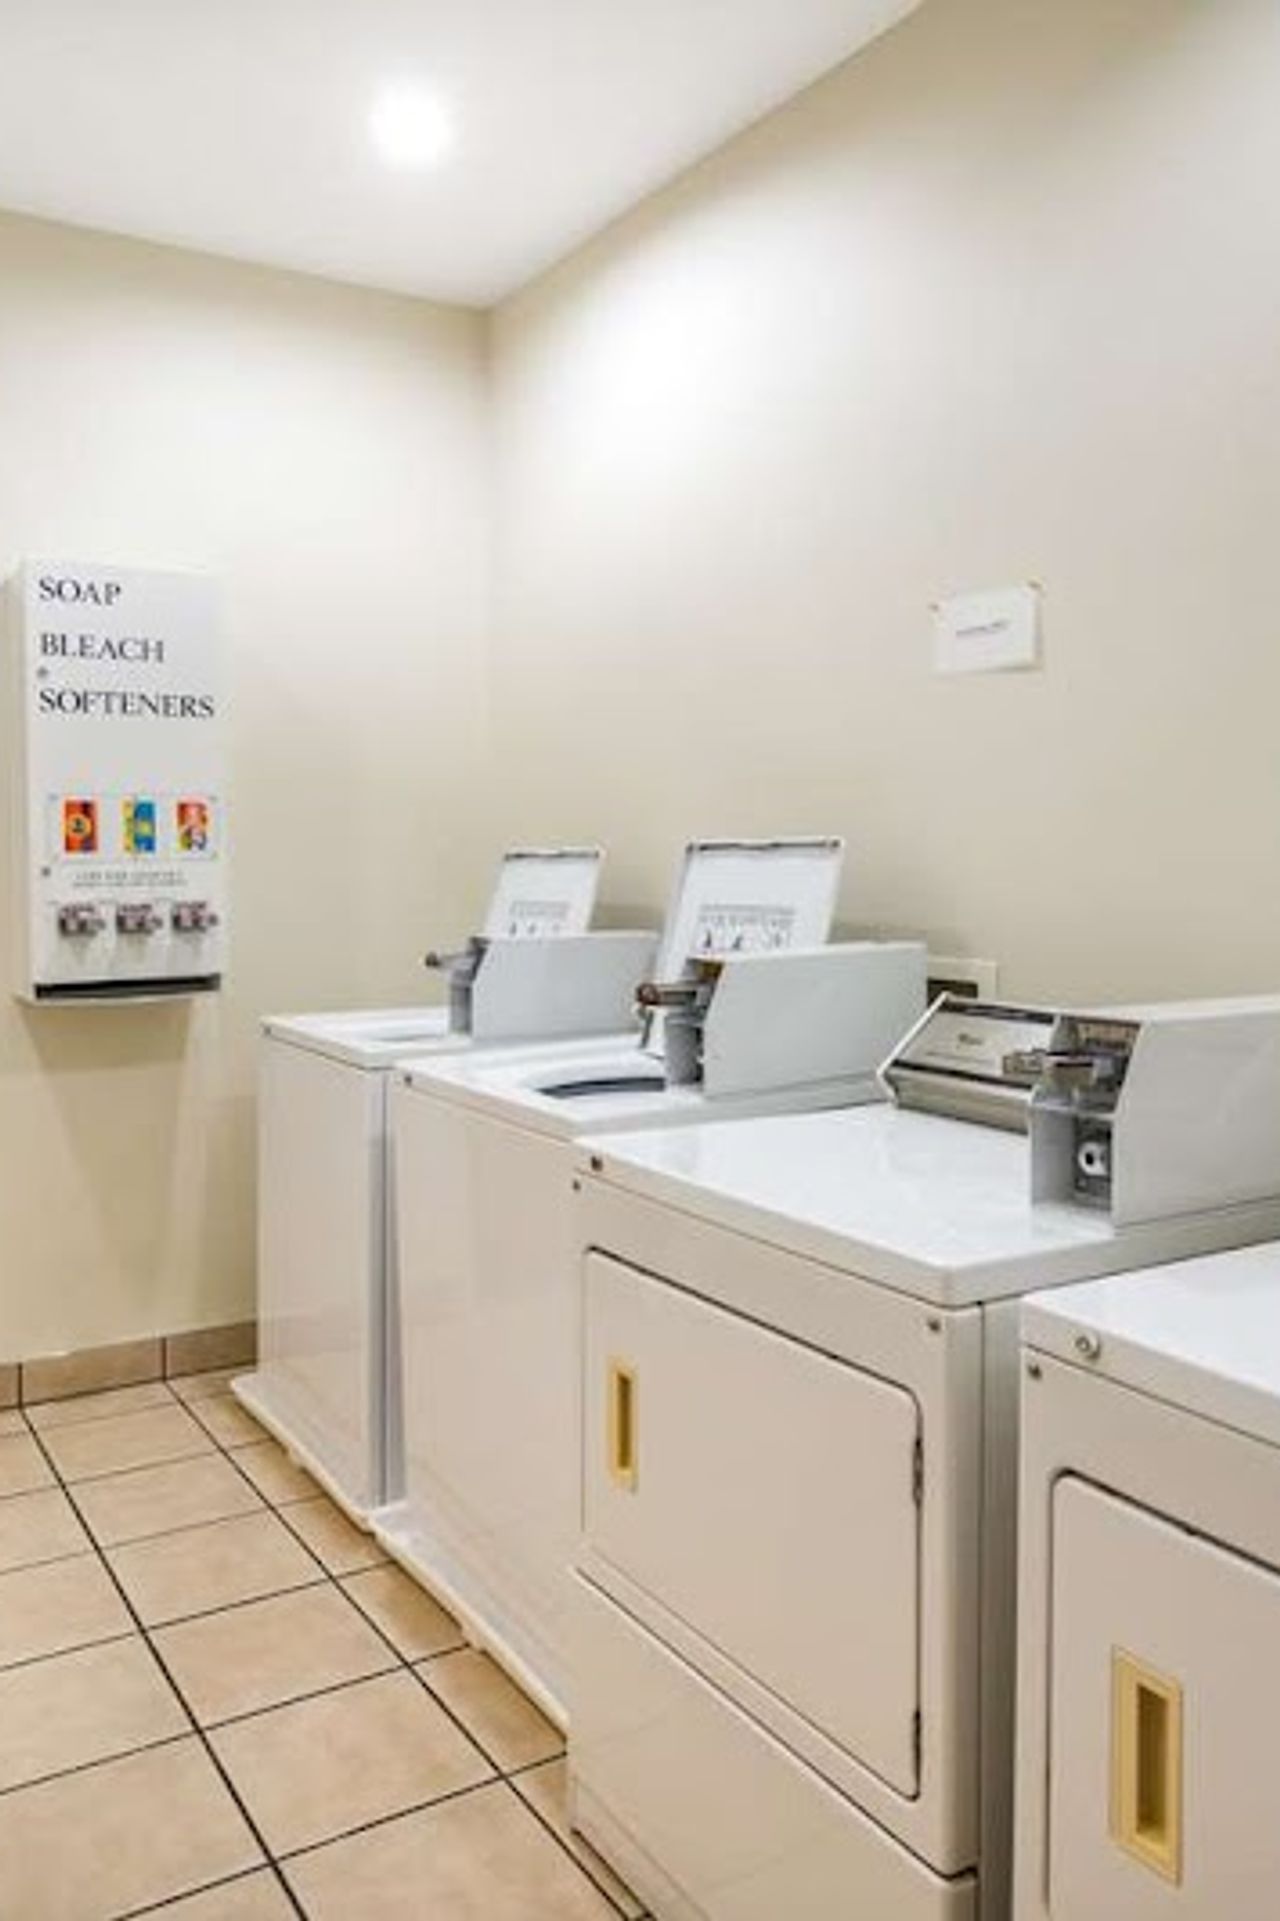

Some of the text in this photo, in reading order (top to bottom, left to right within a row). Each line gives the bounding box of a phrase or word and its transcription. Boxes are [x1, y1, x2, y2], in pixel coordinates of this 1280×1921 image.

[38, 576, 121, 606] SOAP
[40, 632, 164, 664] BLEACH
[38, 687, 215, 719] SOFTENERS
